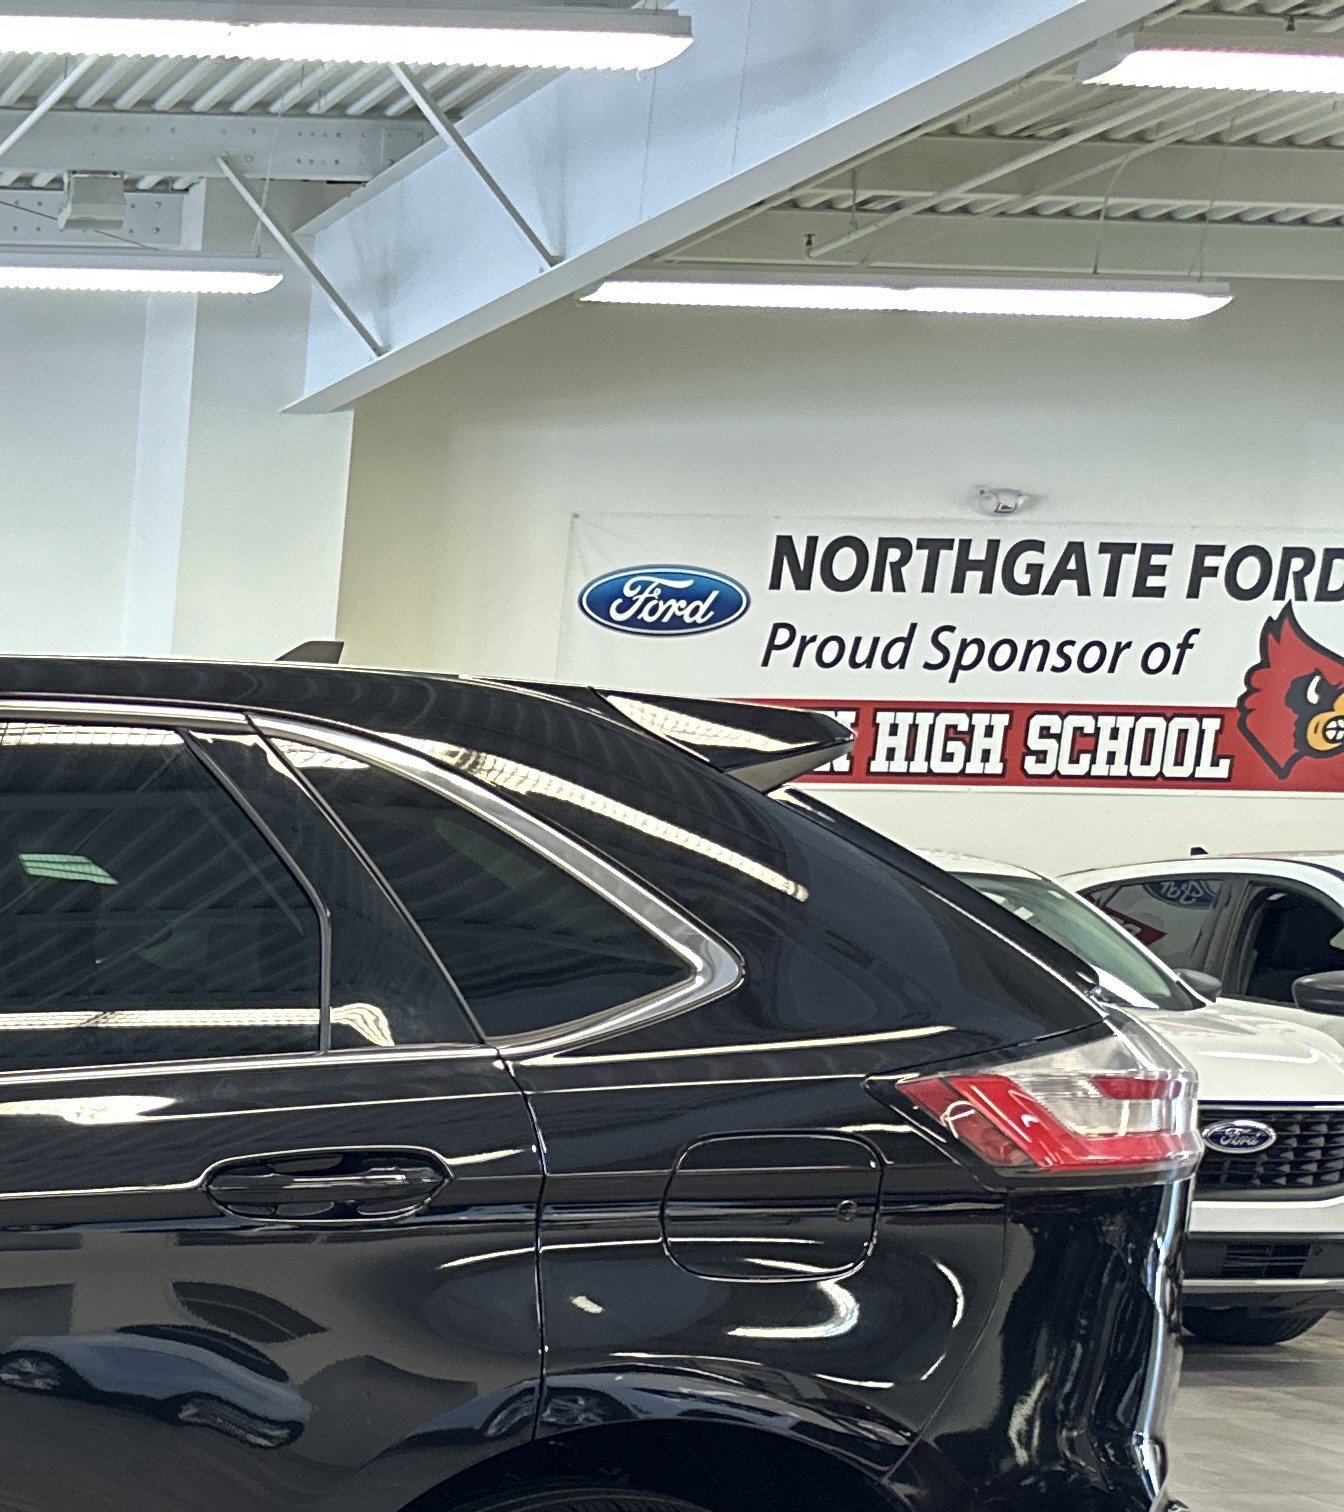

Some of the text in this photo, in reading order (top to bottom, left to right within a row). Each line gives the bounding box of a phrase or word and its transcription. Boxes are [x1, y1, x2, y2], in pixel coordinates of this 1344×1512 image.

[768, 534, 1344, 602] NORTHGATE FORD
[760, 622, 1201, 684] Proud Sponsor of
[868, 711, 1010, 774] HIGH
[1025, 715, 1231, 779] SCHOOL
